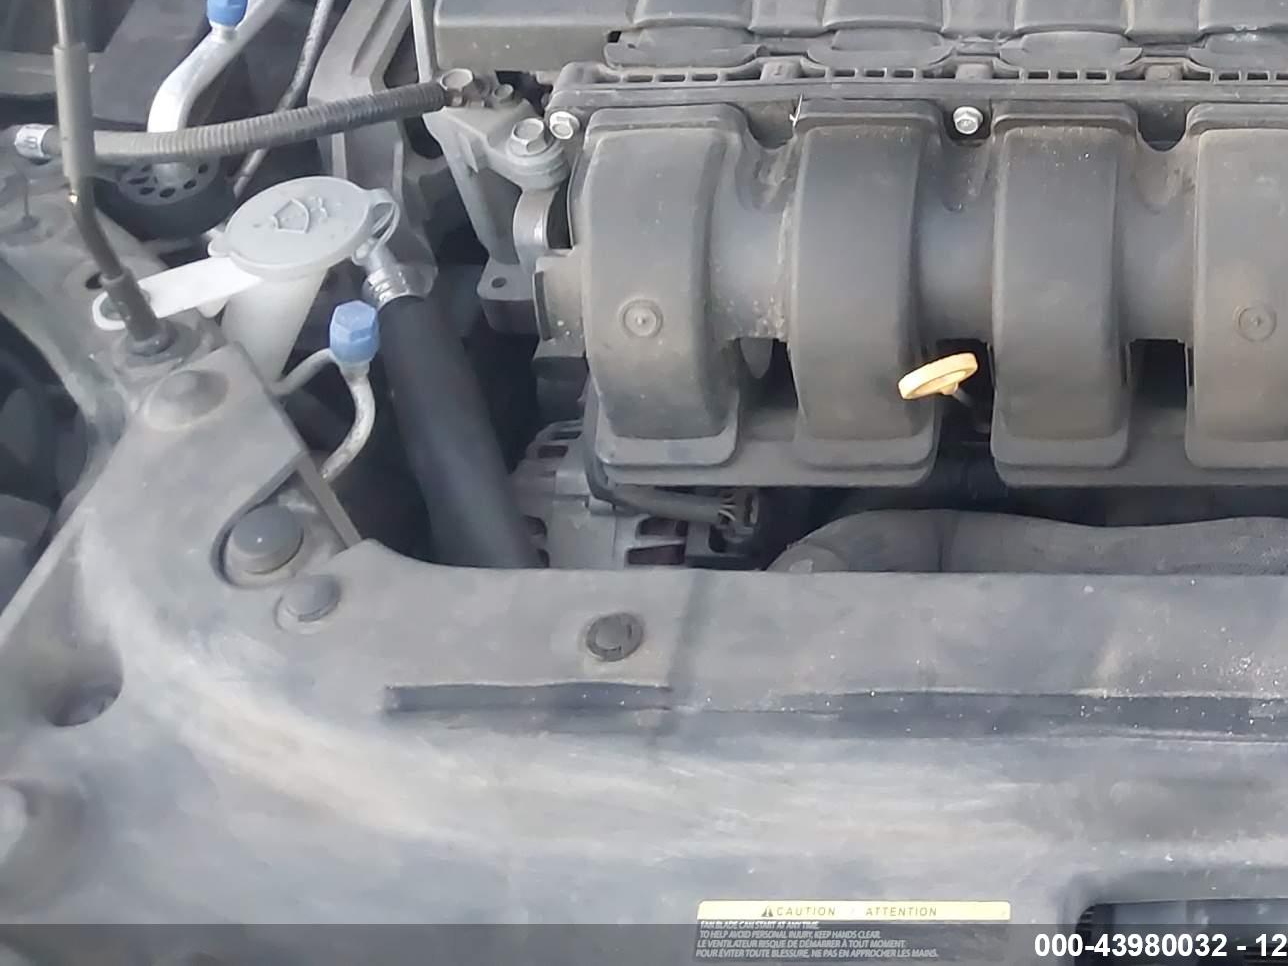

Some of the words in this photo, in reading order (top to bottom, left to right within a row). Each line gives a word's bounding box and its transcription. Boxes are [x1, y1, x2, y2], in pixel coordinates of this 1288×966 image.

[776, 906, 836, 916] CAUTION
[865, 905, 938, 916] ATTENTION
[715, 921, 738, 930] BLADE
[739, 921, 754, 930] CAN
[755, 921, 775, 930] START
[776, 921, 786, 930] AT
[786, 921, 801, 930] ANY
[700, 930, 710, 939] TO
[710, 930, 728, 939] HELP
[728, 930, 752, 939] AVOID
[752, 930, 788, 939] PERSONAL
[813, 930, 832, 939] KEEP
[832, 930, 857, 939] HANDS
[697, 939, 707, 948] LE
[708, 939, 758, 948] VENTILATEUR
[758, 939, 786, 948] RISQUE
[787, 939, 798, 948] DE
[849, 939, 869, 948] TOUT
[696, 949, 718, 958] POUR
[718, 949, 745, 958] ÉVITER
[745, 949, 770, 958] TOUTE
[811, 949, 822, 958] NE
[823, 949, 838, 958] PAS
[838, 949, 850, 958] EN
[851, 949, 896, 958] APPROCHER
[897, 949, 911, 958] LES
